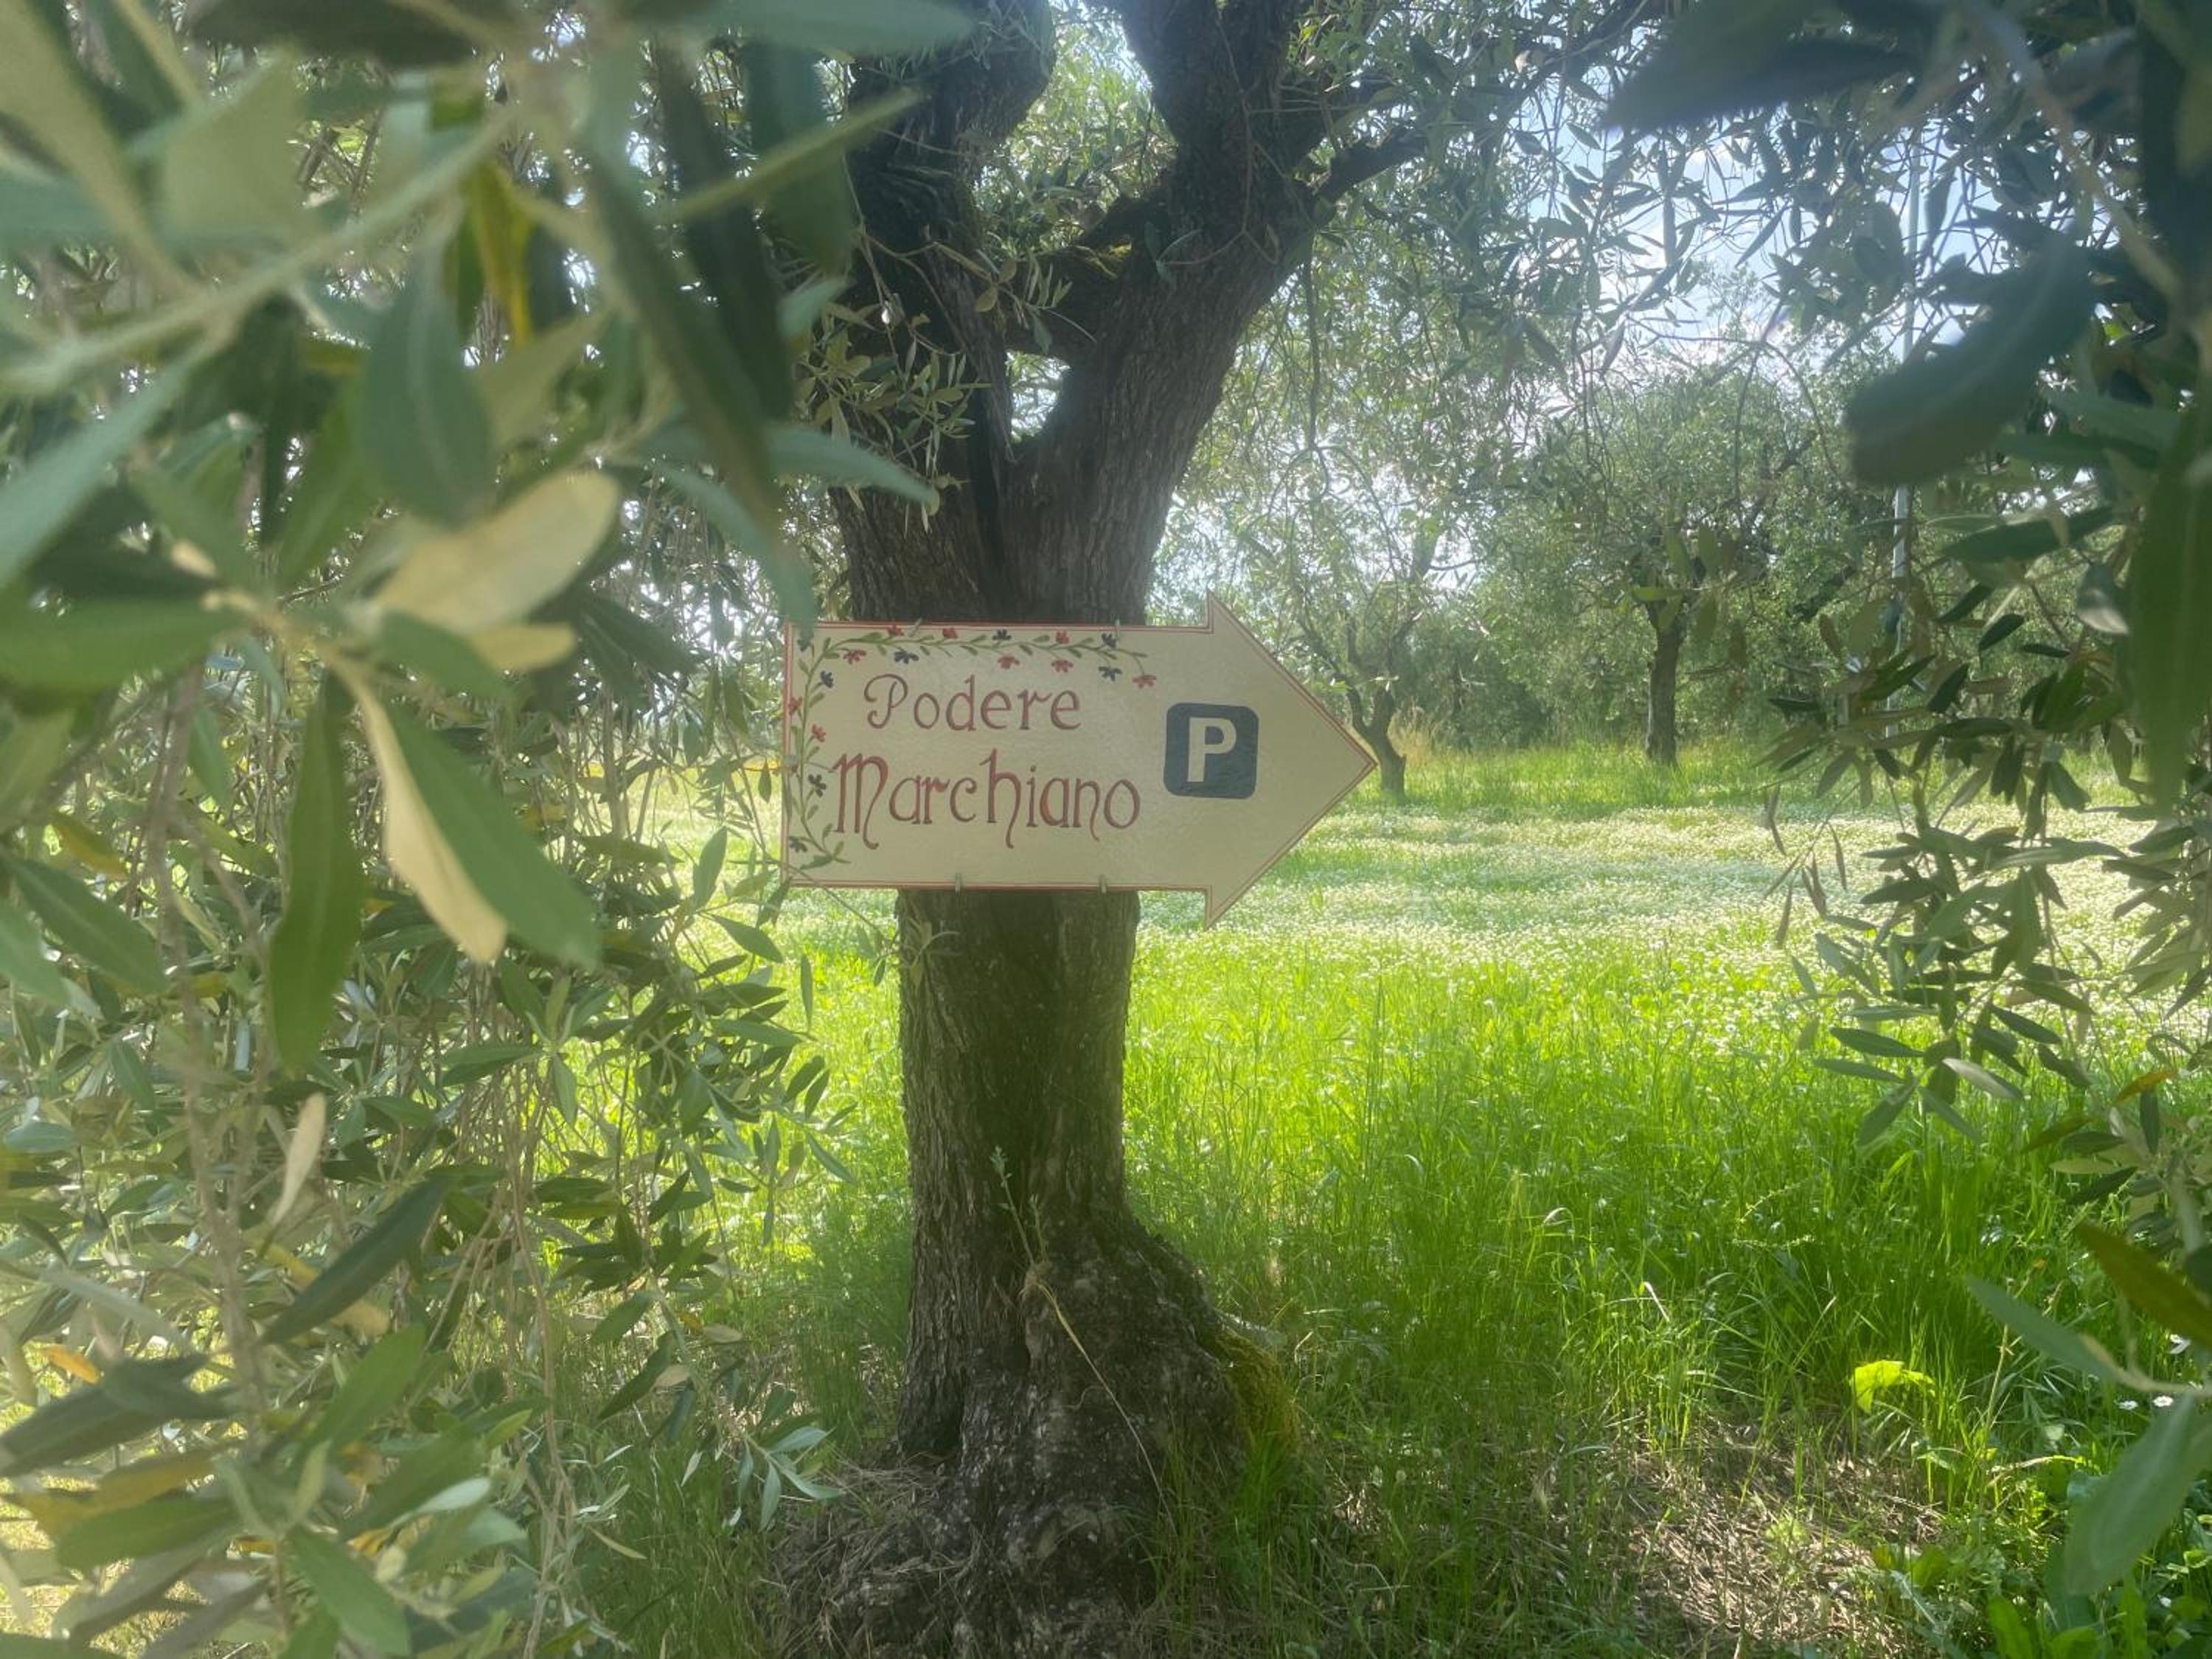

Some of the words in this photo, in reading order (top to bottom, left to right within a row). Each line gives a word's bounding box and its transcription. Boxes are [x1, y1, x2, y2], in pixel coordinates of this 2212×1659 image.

[863, 672, 1083, 731] Podere
[1186, 716, 1237, 783] P
[833, 748, 1141, 849] Marchiano
